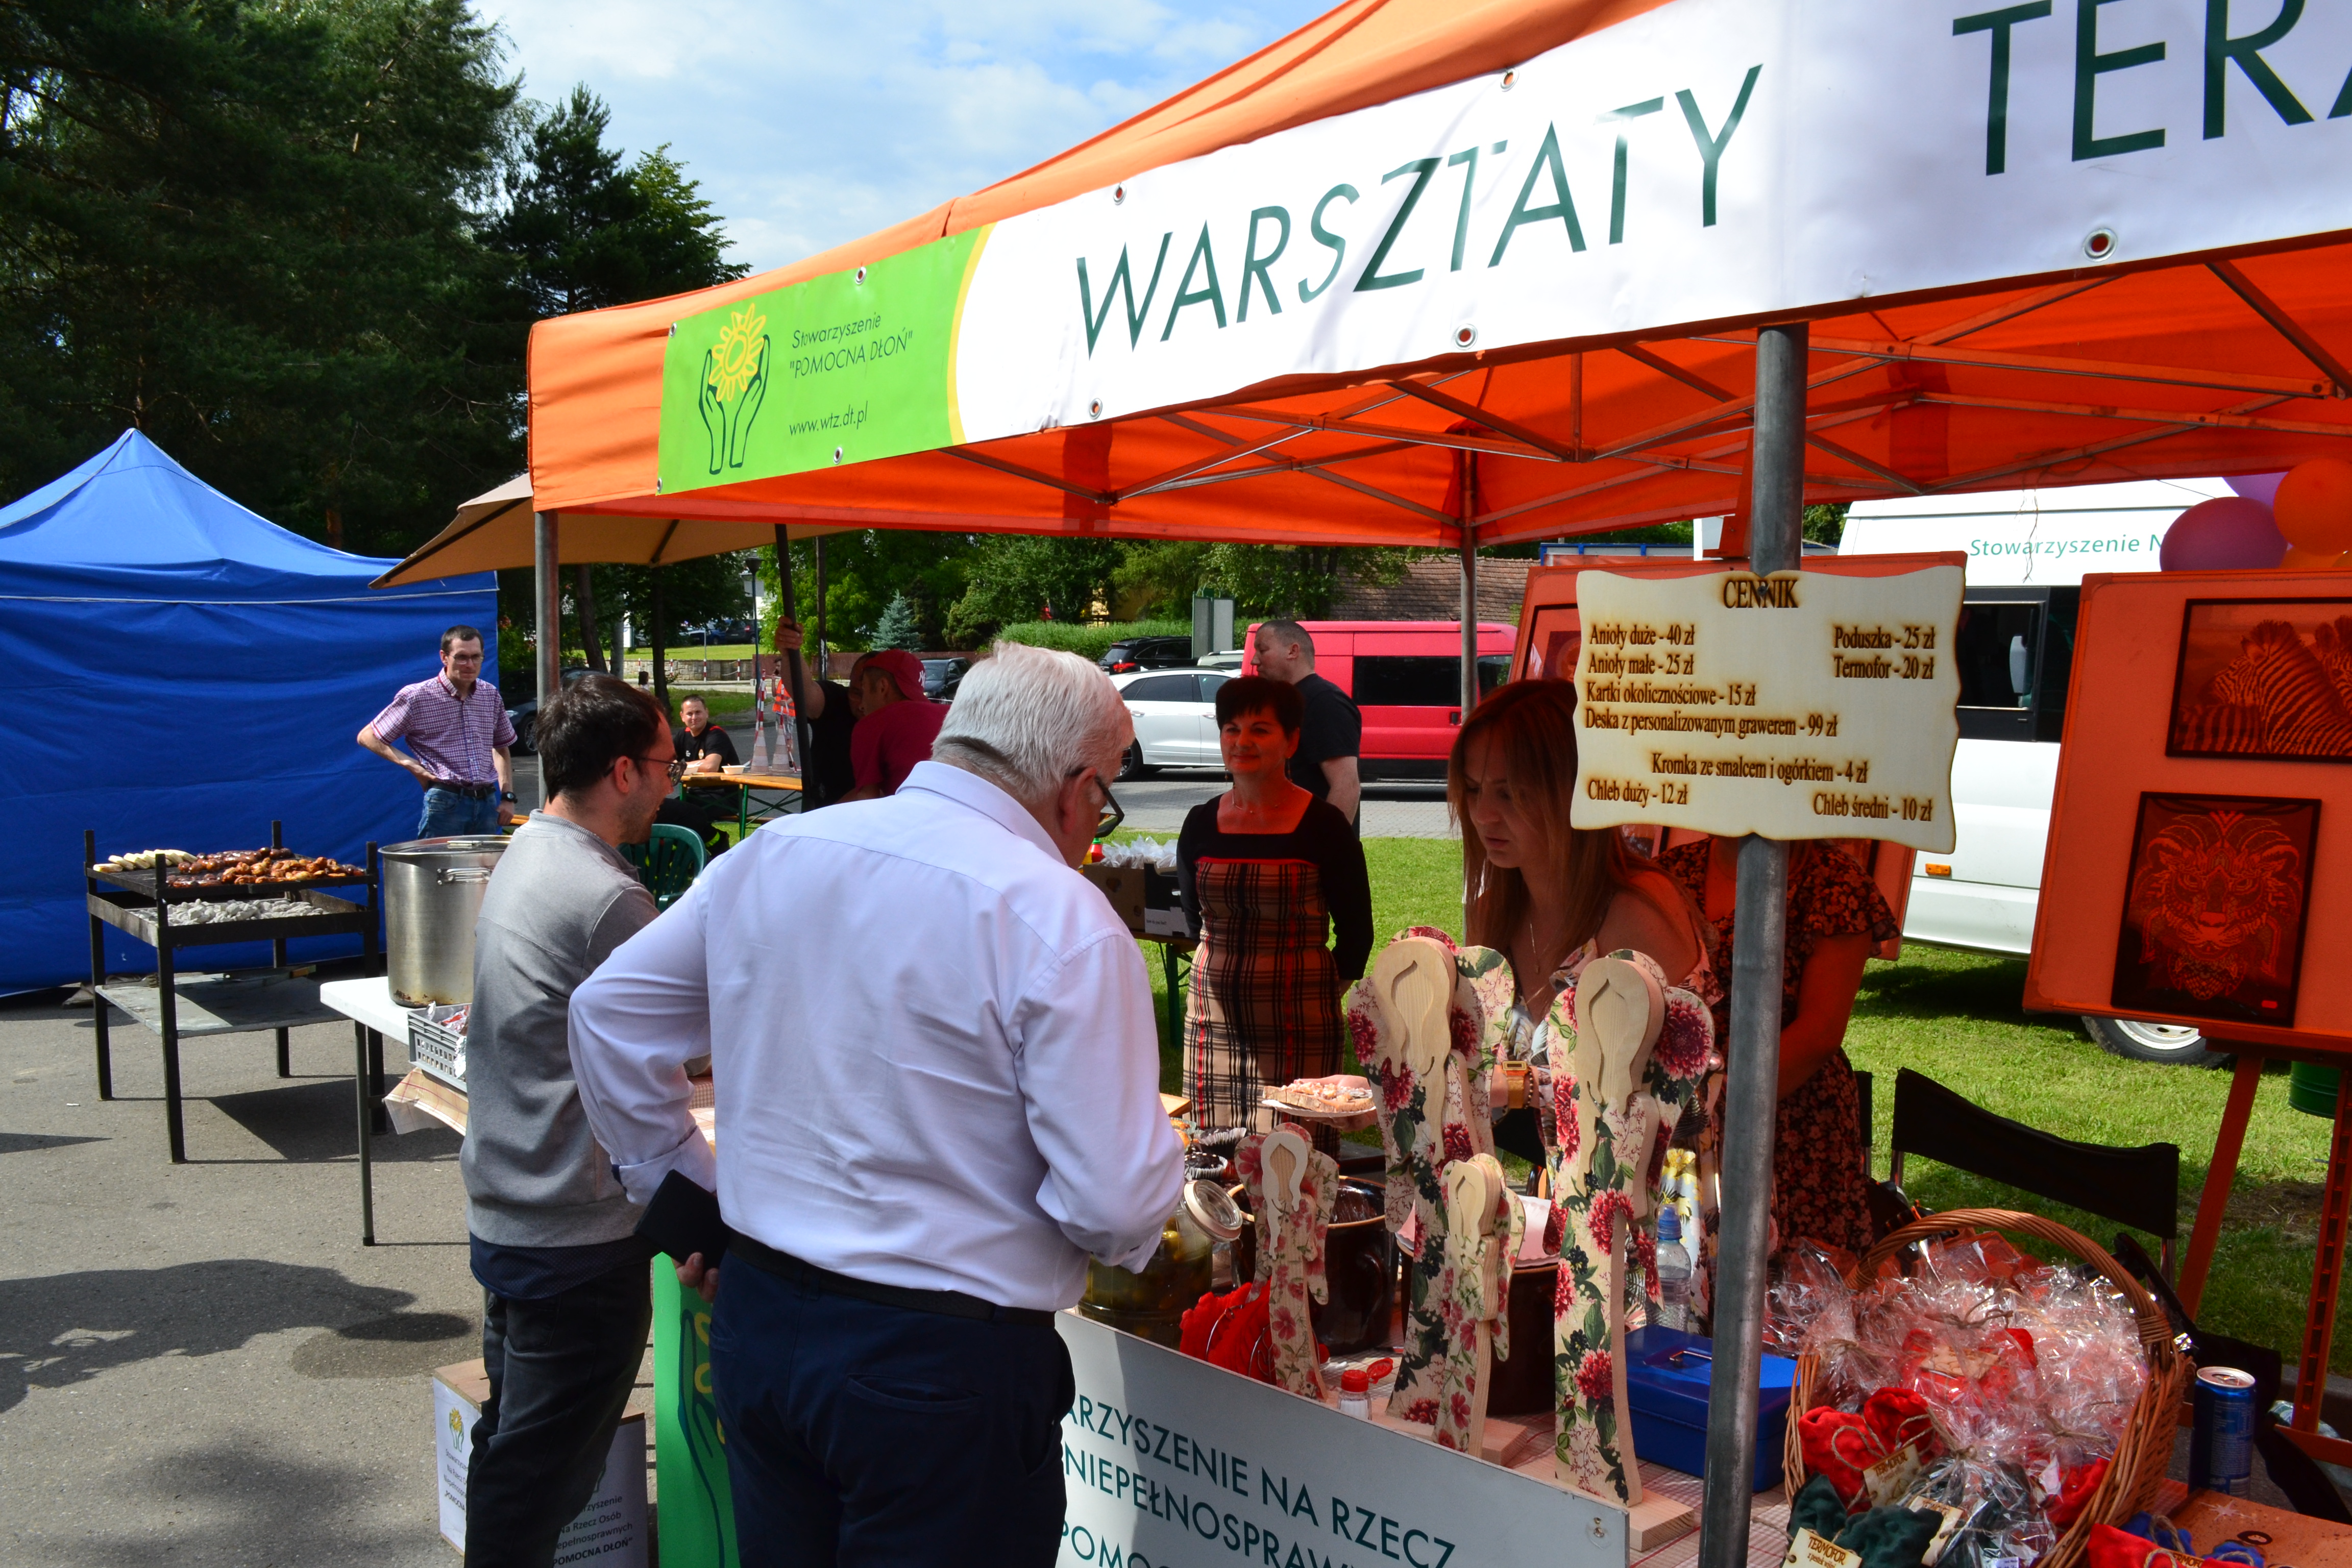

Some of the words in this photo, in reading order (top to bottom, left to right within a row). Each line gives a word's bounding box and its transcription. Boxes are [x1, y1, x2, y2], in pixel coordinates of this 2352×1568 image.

[1076, 63, 1763, 361] WARSZTATY
[1952, 0, 2352, 176] TER
[792, 311, 881, 349] Stowarzyszenie
[789, 401, 868, 436] www.wtz.dt.pl
[1970, 534, 2140, 559] Stowarzyszenie
[1723, 579, 1799, 608] CENNIK
[1590, 623, 1627, 650] Anioły
[1630, 625, 1656, 645] duże
[1667, 625, 1681, 646] 40
[1684, 624, 1695, 646] zł
[1834, 626, 1892, 649] Poduszka
[1903, 627, 1919, 649] 25
[1923, 627, 1935, 649] zł
[1588, 653, 1626, 679] Anioły
[1628, 654, 1655, 675] małe
[1666, 654, 1680, 675] 25
[1683, 654, 1694, 675] zł
[1834, 655, 1892, 678] Termofor
[1902, 656, 1919, 679] 20
[1922, 656, 1933, 679] zł
[1586, 681, 1621, 702] Kartki
[1624, 682, 1716, 705] okolicznościowe
[1729, 685, 1742, 705] 15
[1745, 685, 1756, 706] zł
[1585, 708, 1619, 728] Deska
[1622, 715, 1628, 729] z
[1631, 711, 1735, 738] personalizowanym
[1738, 719, 1796, 740] grawerem
[1808, 715, 1823, 736] 99
[1826, 715, 1837, 737] zł
[1652, 752, 1697, 775] Kromka
[1700, 761, 1712, 776] ze
[1716, 756, 1767, 778] smalcem
[1770, 757, 1774, 779] i
[1777, 758, 1833, 786] ogórkiem
[1845, 761, 1853, 782] 4
[1856, 761, 1868, 783] zł
[1587, 779, 1620, 801] Chleb
[1623, 781, 1649, 808] duży
[1661, 784, 1674, 804] 12
[1677, 784, 1687, 805] zł
[1814, 793, 1849, 816] Chleb
[1852, 796, 1889, 819] średni
[1902, 798, 1917, 821] 10
[1920, 798, 1932, 822] zł
[582, 1496, 622, 1513] rzyszenie
[1262, 1466, 1319, 1527] NA
[1332, 1497, 1455, 1568] RZECZ
[573, 1518, 597, 1531] Rzecz
[599, 1511, 622, 1524] Osób
[1808, 1537, 1846, 1565] TERMOFOR
